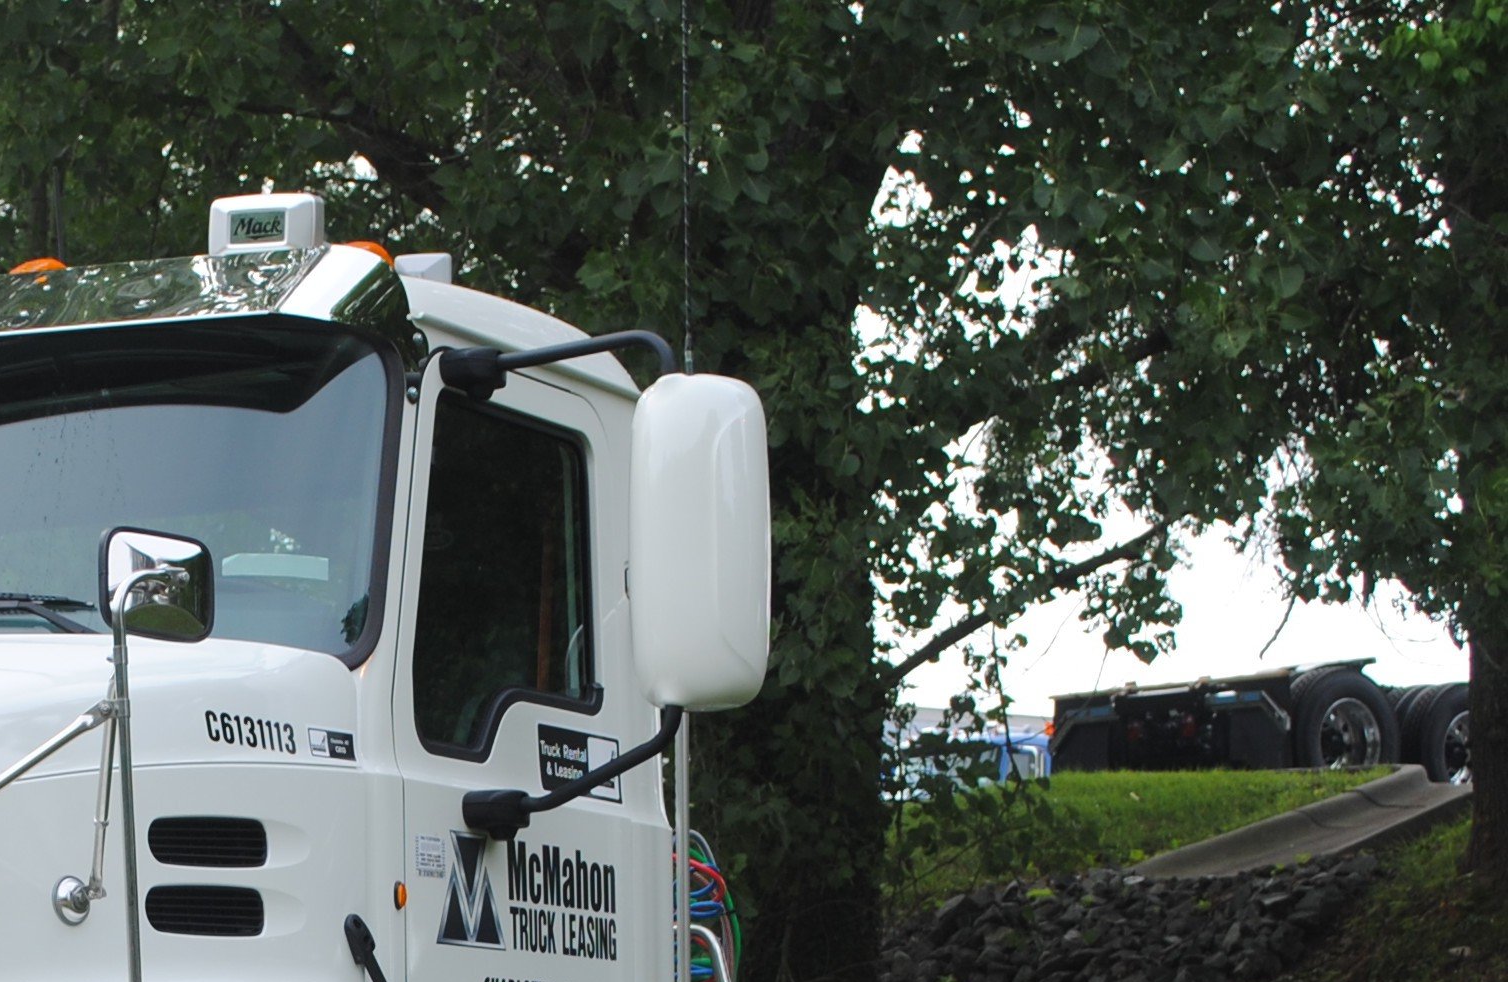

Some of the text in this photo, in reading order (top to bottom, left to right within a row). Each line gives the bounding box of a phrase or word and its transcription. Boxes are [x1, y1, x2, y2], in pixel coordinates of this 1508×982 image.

[233, 216, 283, 238] Mack
[205, 710, 297, 754] C6131113
[540, 740, 587, 762] Truck Rental
[546, 761, 553, 775] &
[507, 839, 616, 913] McMahon
[510, 906, 617, 961] TRUCK LEASING
